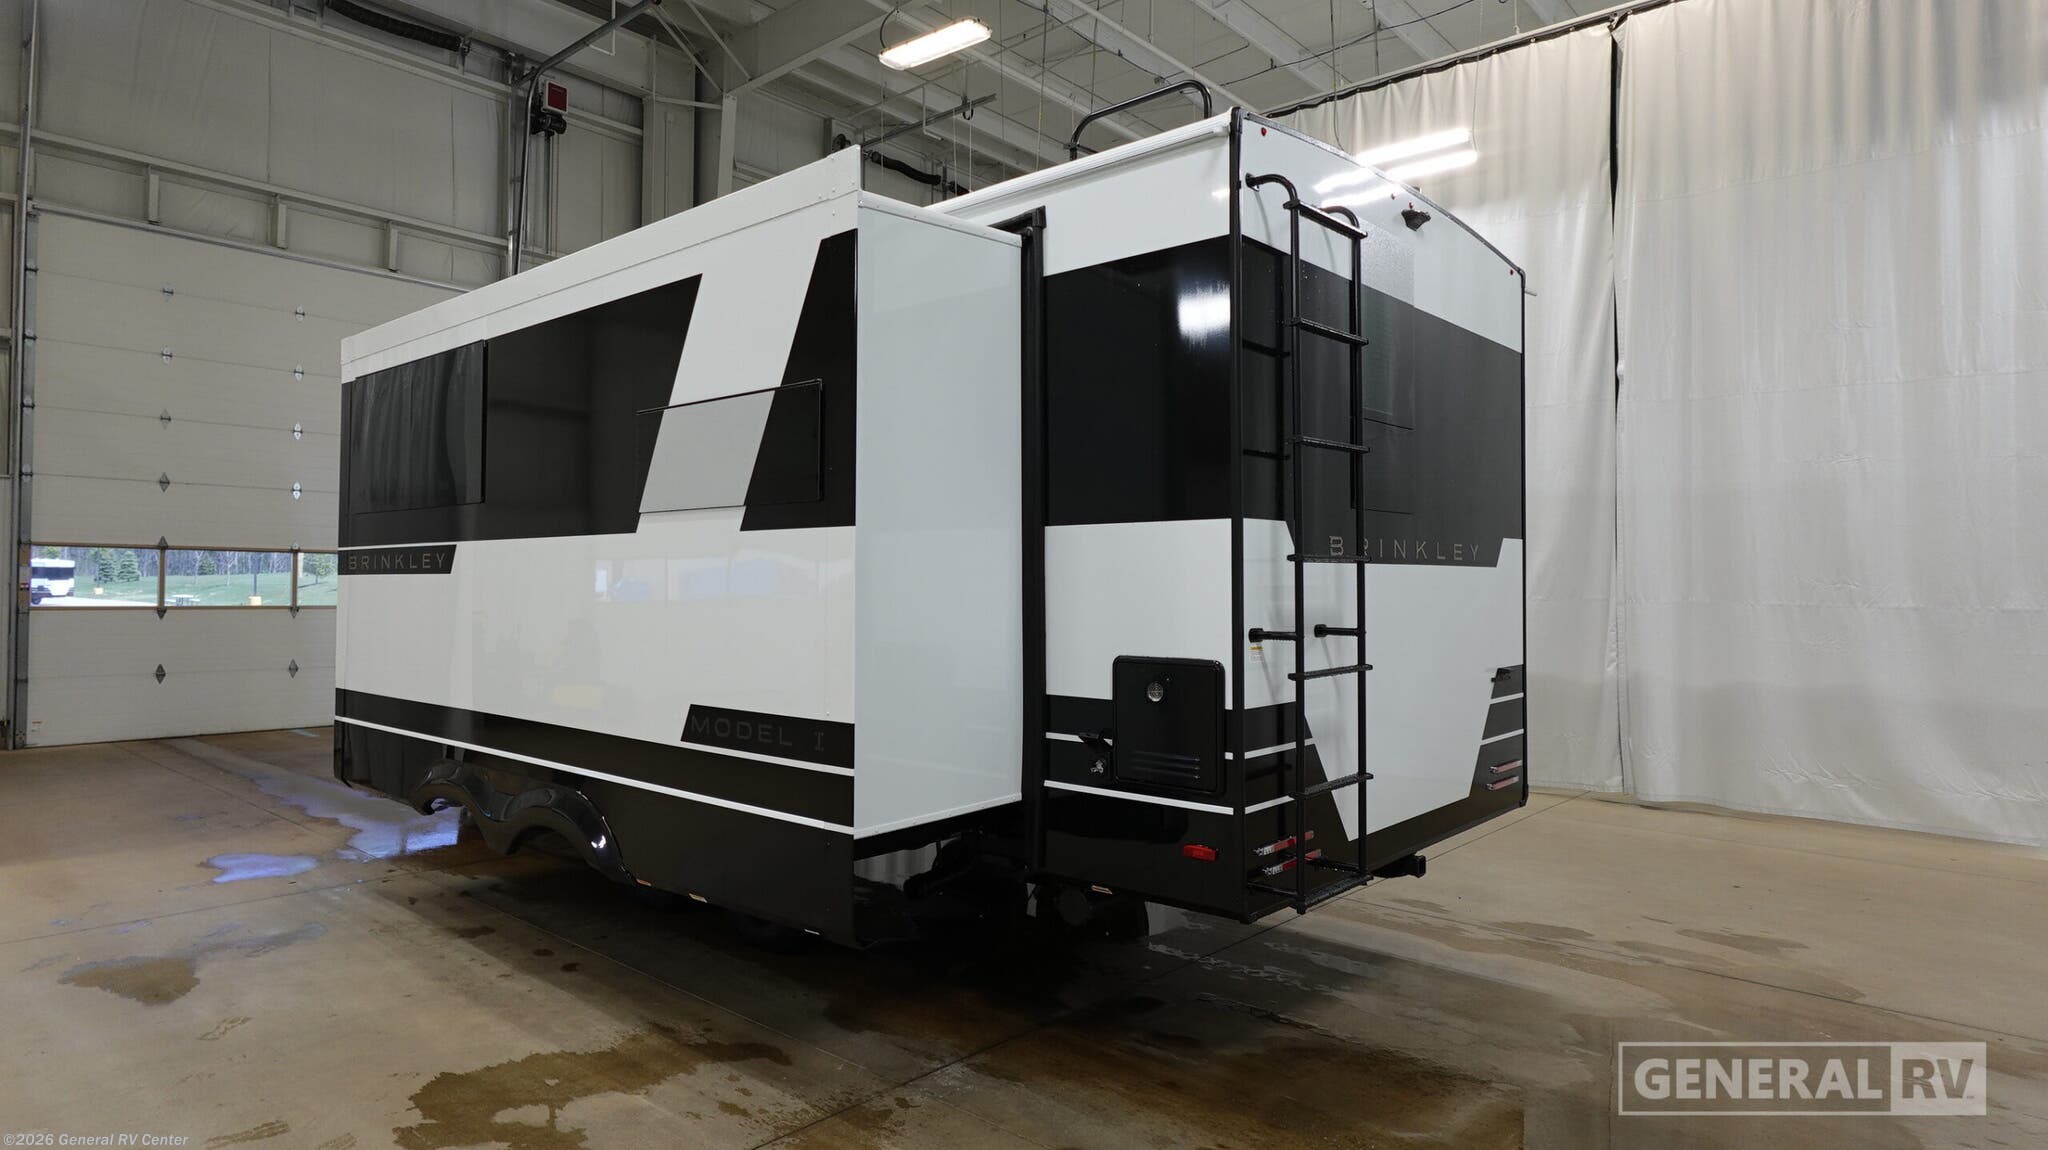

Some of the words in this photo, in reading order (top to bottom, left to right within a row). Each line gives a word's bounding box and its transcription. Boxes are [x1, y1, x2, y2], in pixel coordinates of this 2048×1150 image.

[348, 553, 446, 570] BRINKLEY
[690, 715, 793, 746] MODEL
[814, 731, 825, 751] I
